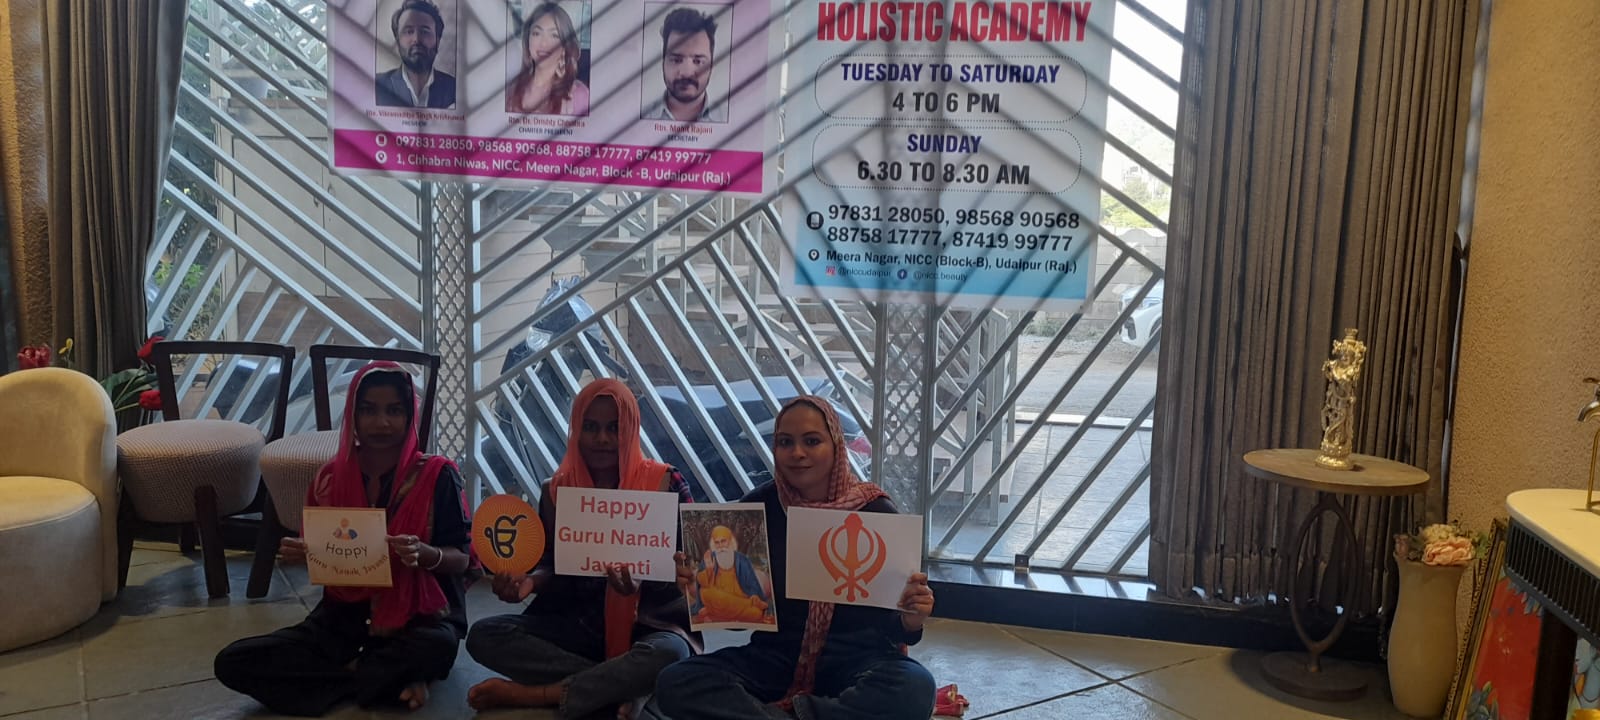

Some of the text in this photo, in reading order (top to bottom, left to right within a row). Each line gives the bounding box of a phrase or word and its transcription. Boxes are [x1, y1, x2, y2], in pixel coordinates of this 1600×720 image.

[817, 1, 1092, 42] HOLISTIC ACADEMY
[841, 63, 1061, 84] TUESDAY TO SATURDAY
[893, 93, 1000, 113] 4 TO 6 PM
[396, 136, 711, 164] 097831 28050, 98568 90568, 88758 17777, 87419 99777
[907, 133, 983, 154] SUNDAY
[397, 154, 405, 166] 1,
[408, 154, 451, 167] Chhabra
[454, 158, 489, 171] Niwas,
[492, 159, 523, 173] NICC,
[526, 162, 560, 174] Meera
[564, 164, 599, 178] Nagar,
[602, 166, 632, 178] Block
[655, 168, 700, 184] Udaipur
[702, 172, 731, 185] (Raj.)
[857, 160, 1030, 185] 6.30 TO 8.30 AM
[828, 205, 1080, 229] 97831 28050, 98568 90568
[827, 227, 1073, 251] 88758 17777, 87419 99777
[826, 251, 1077, 275] Meera Nagar, NICC (Block-B), Udaipur (Raj.)
[580, 496, 650, 520] Happy
[558, 527, 670, 548] Guru Nanak
[325, 542, 368, 559] Happy
